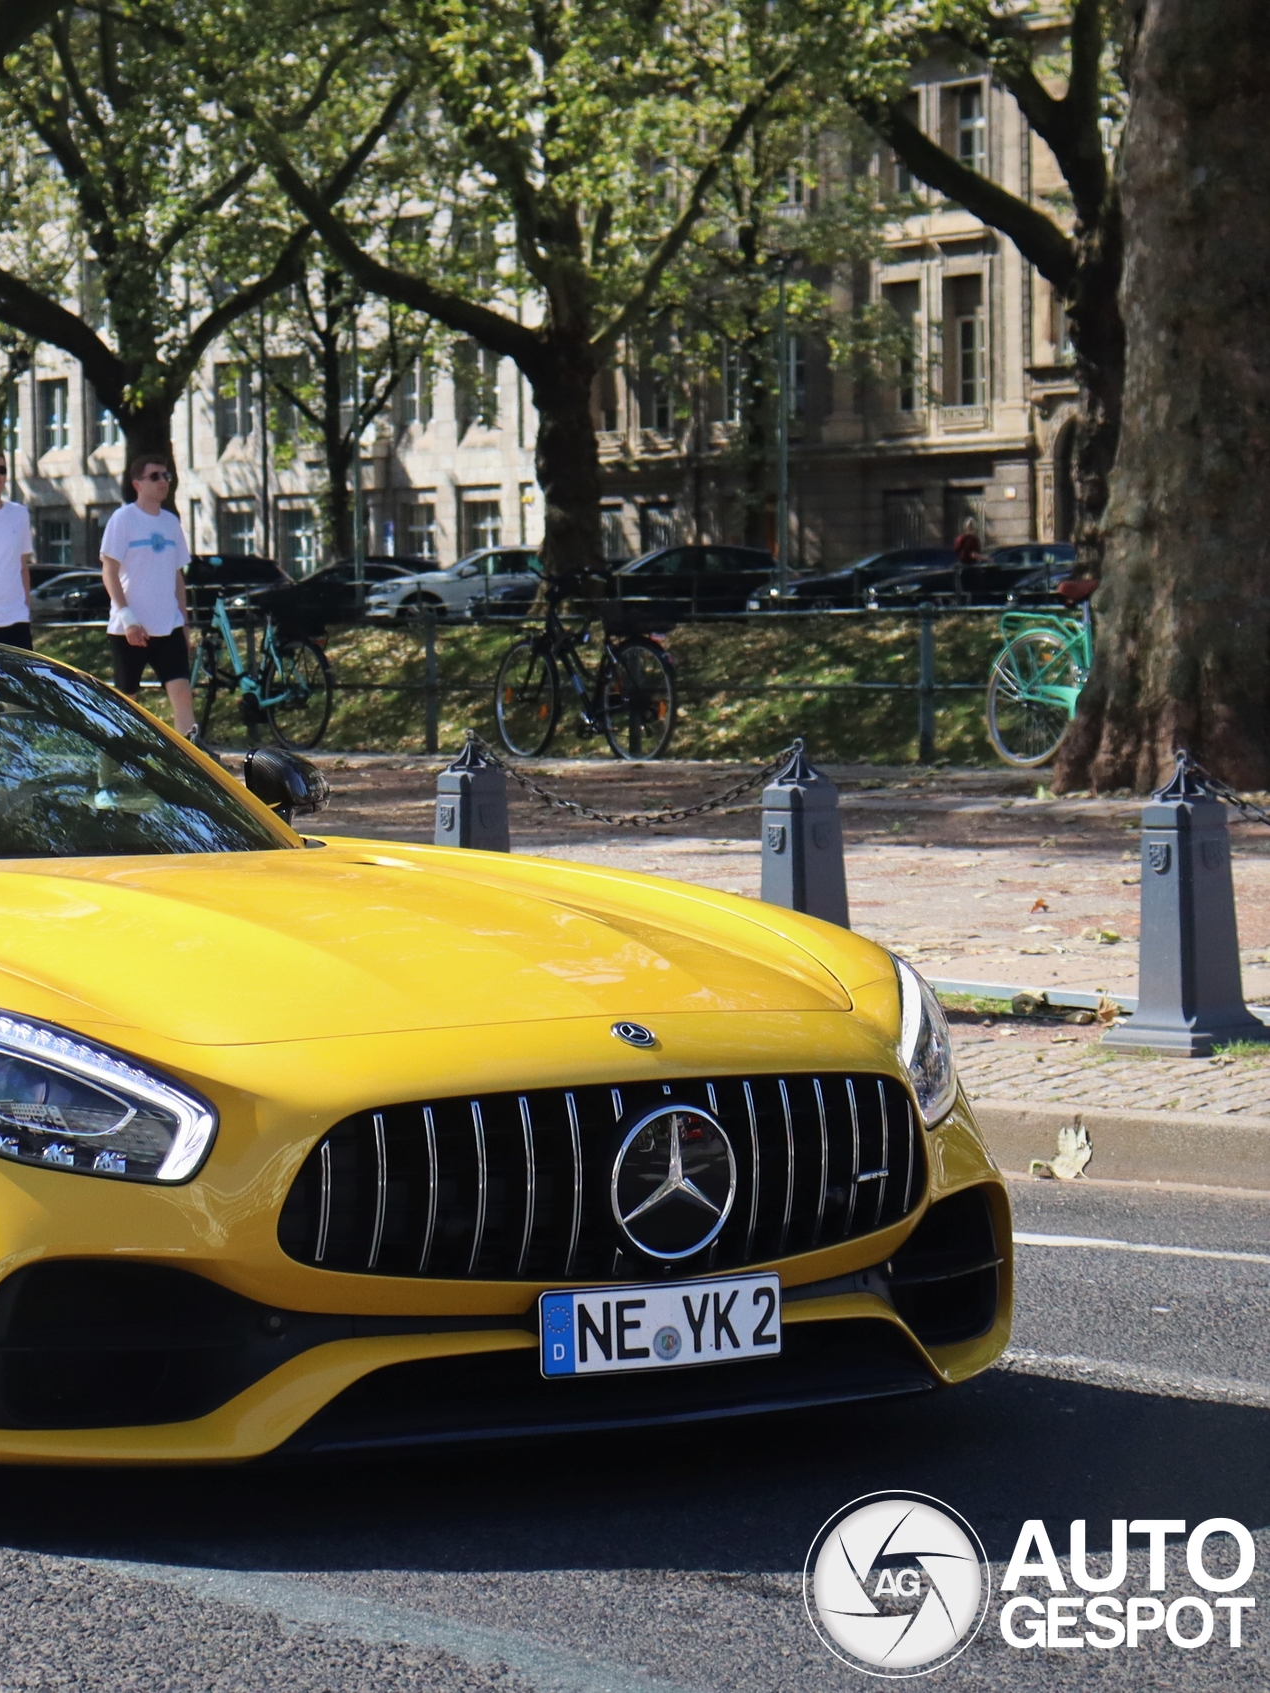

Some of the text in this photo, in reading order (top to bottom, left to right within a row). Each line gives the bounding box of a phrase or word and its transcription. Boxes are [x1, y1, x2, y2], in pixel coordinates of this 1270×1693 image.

[553, 1343, 566, 1361] D
[577, 1299, 650, 1363] NE
[682, 1289, 741, 1353] YK
[752, 1286, 778, 1346] 2
